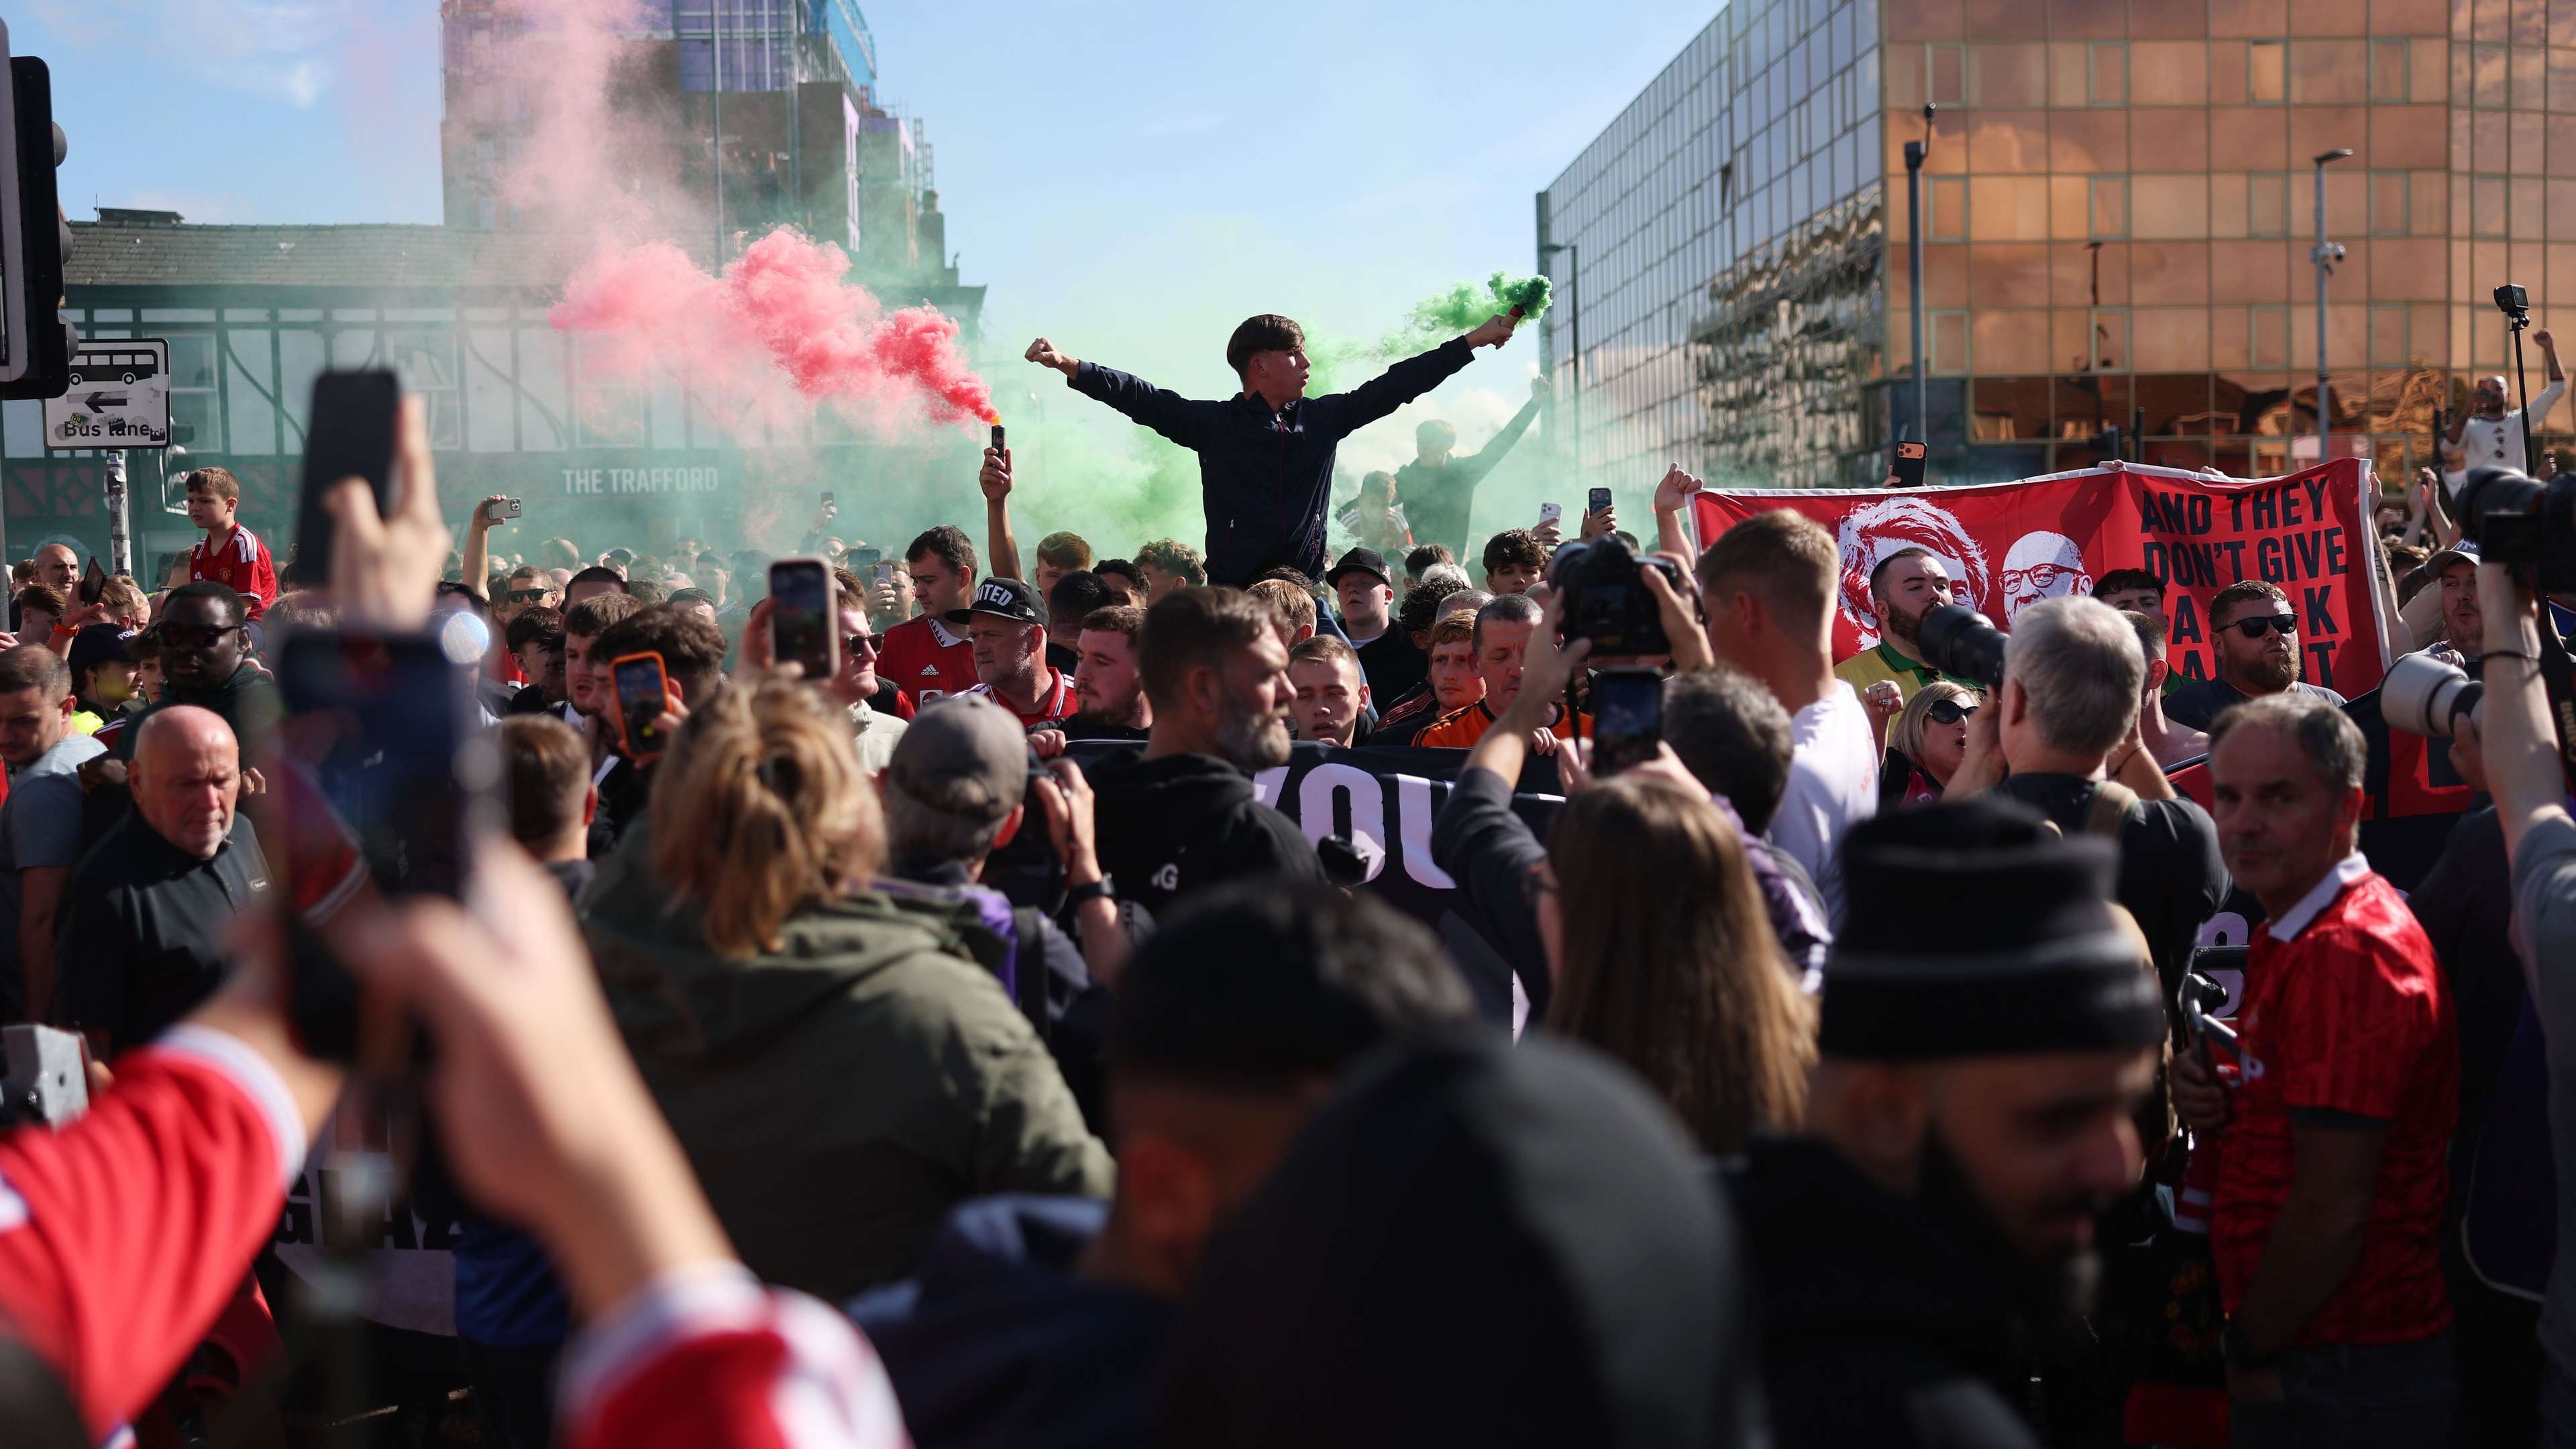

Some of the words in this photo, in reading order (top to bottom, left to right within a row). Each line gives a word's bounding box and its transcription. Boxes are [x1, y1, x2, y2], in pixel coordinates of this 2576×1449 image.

[64, 421, 101, 437] Bus
[562, 469, 603, 494] THE
[608, 467, 719, 493] TRAFFORD
[2141, 490, 2212, 535] AND
[2226, 476, 2329, 532] THEY
[2143, 539, 2246, 588] DON'T
[2257, 526, 2349, 584] GIVE
